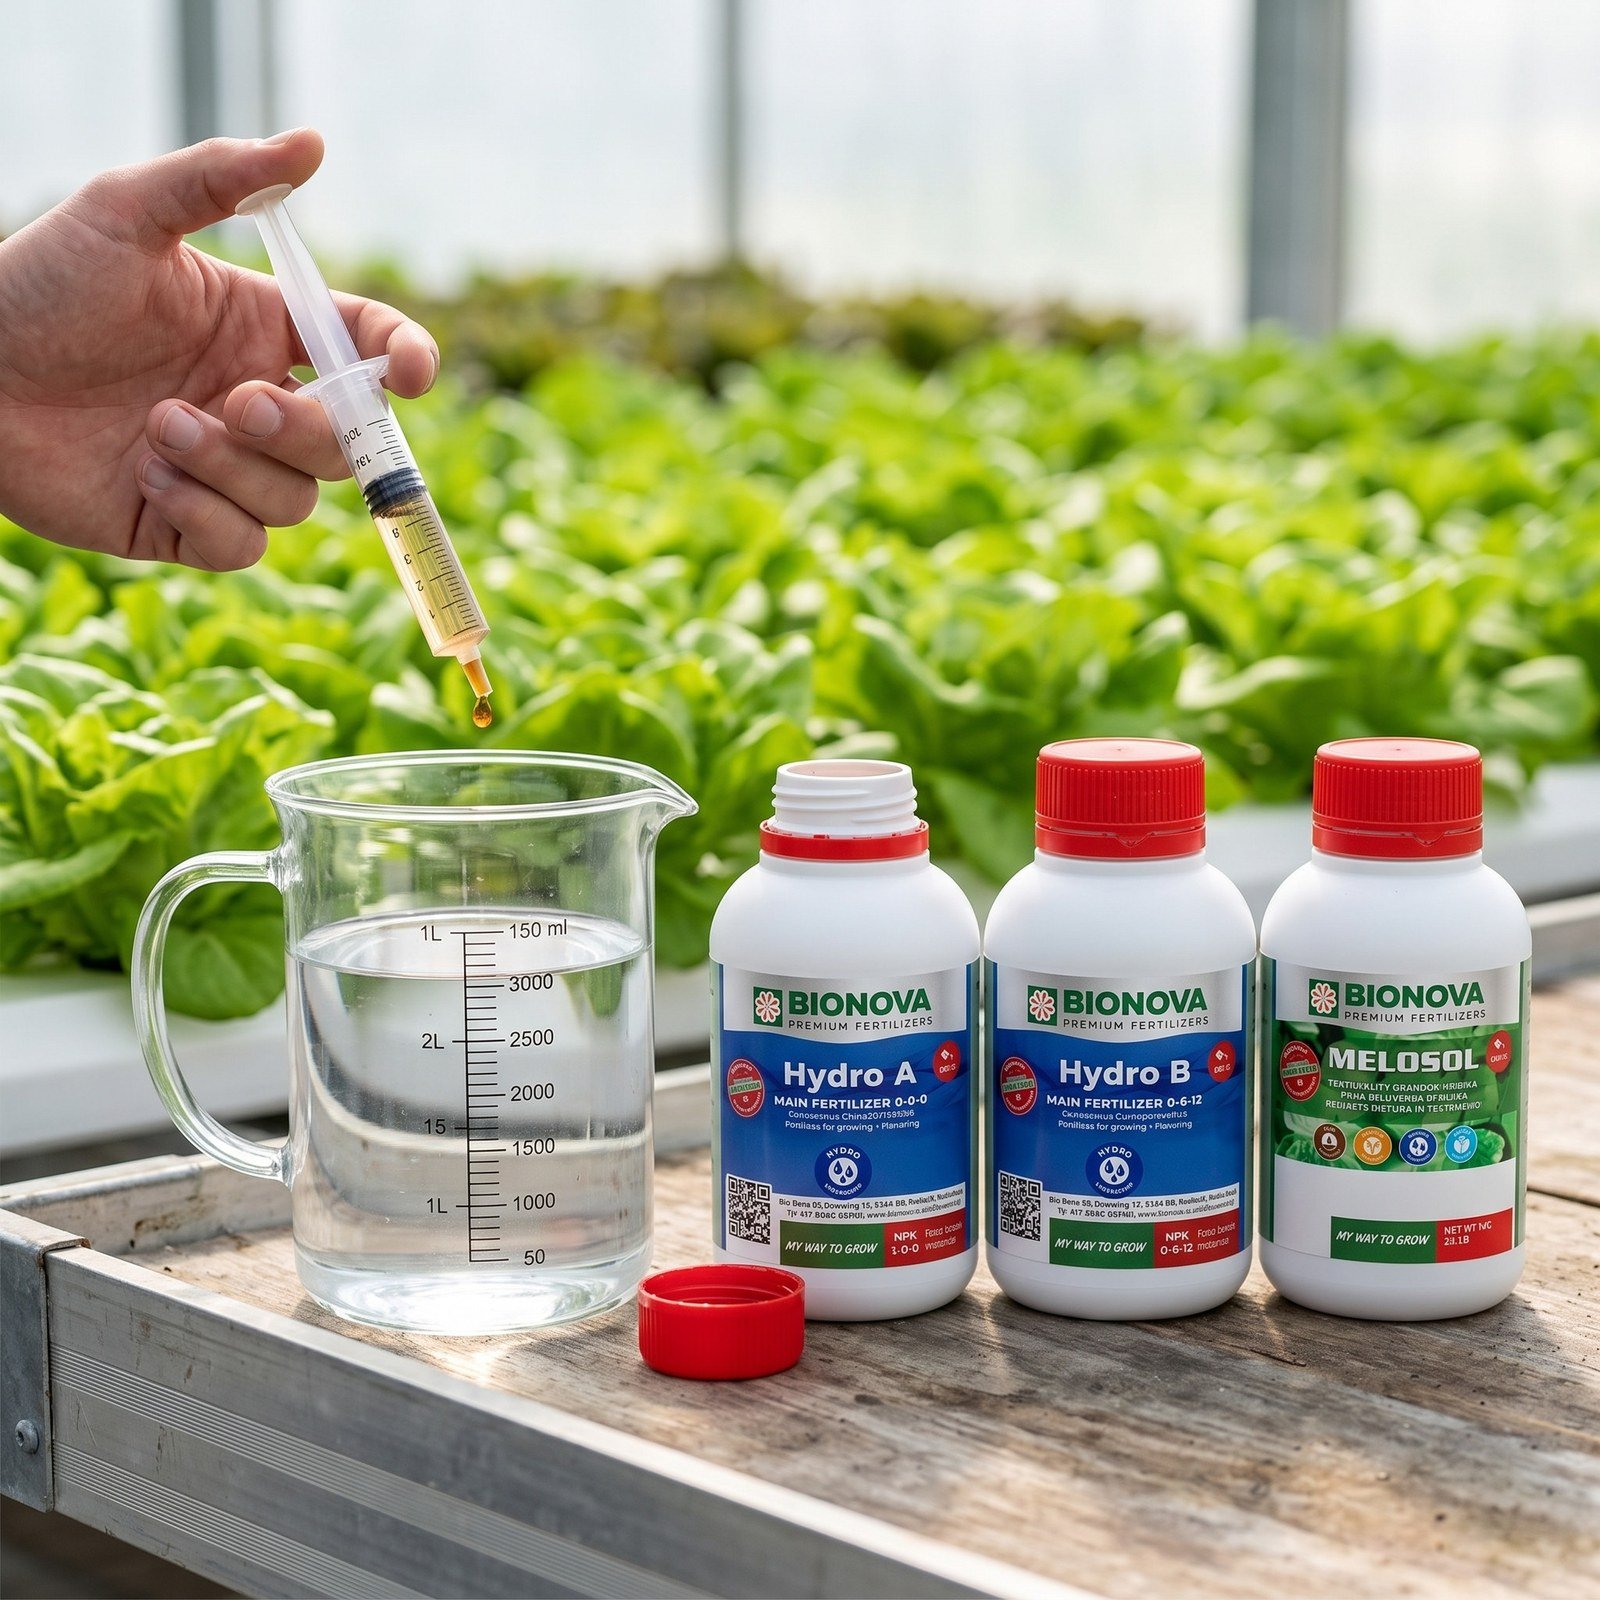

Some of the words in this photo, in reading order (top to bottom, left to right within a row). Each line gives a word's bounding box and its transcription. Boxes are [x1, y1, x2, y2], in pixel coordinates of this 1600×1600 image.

[415, 580, 424, 593] 2
[429, 609, 436, 620] 1
[420, 926, 442, 942] 1L
[510, 922, 542, 939] 150
[547, 919, 568, 936] ml
[509, 973, 554, 992] 3000
[788, 987, 932, 1017] BIONOVA
[1063, 987, 1208, 1016] BIONOVA
[1344, 981, 1485, 1009] BIONOVA
[788, 1019, 848, 1031] PREMIUM
[855, 1016, 933, 1031] FERTILIZERS
[1063, 1018, 1124, 1030] PREMIUM
[1131, 1016, 1209, 1030] FERTILIZERS
[1344, 1011, 1404, 1023] PREMIUM
[1411, 1009, 1486, 1023] FERTILIZERS
[422, 1033, 445, 1050] 2L
[510, 1028, 554, 1048] 2500
[1329, 1047, 1479, 1073] MELOSOL
[784, 1061, 884, 1093] Hydro
[893, 1061, 917, 1086] A
[1059, 1059, 1160, 1092] Hydro
[1170, 1059, 1191, 1085] B
[510, 1082, 555, 1102] 2000
[774, 1095, 808, 1108] MAIN
[812, 1096, 890, 1110] FERTILIZER
[895, 1094, 928, 1107] 0-0-0
[1046, 1095, 1080, 1108] MAIN
[1084, 1096, 1163, 1110] FERTILIZER
[1166, 1094, 1203, 1107] 0-6-12
[1414, 1105, 1425, 1113] IN
[424, 1119, 446, 1134] 15
[822, 1122, 835, 1131] for
[836, 1122, 873, 1132] growing
[1096, 1122, 1109, 1131] for
[1110, 1122, 1147, 1133] growing
[513, 1137, 556, 1157] 1500
[1097, 1146, 1132, 1158] HYDRO
[426, 1198, 448, 1214] 1L
[514, 1192, 556, 1212] 1000
[779, 1198, 791, 1206] Bio
[1049, 1196, 1061, 1204] Bio
[893, 1230, 917, 1242] NPK
[1165, 1230, 1189, 1242] NPK
[1444, 1224, 1463, 1235] NET
[1463, 1223, 1477, 1233] WT
[1054, 1238, 1073, 1249] MY
[1073, 1240, 1096, 1251] WAY
[1098, 1242, 1112, 1252] TO
[1113, 1242, 1148, 1253] GROW
[1336, 1230, 1354, 1241] MY
[1355, 1232, 1378, 1244] WAY
[1380, 1234, 1394, 1245] TO
[1395, 1234, 1431, 1246] GROW
[785, 1241, 804, 1252] MY
[804, 1242, 827, 1253] WAY
[829, 1243, 842, 1254] TO
[844, 1242, 878, 1254] GROW
[1160, 1243, 1193, 1255] 0-6-12
[524, 1249, 546, 1266] 50
